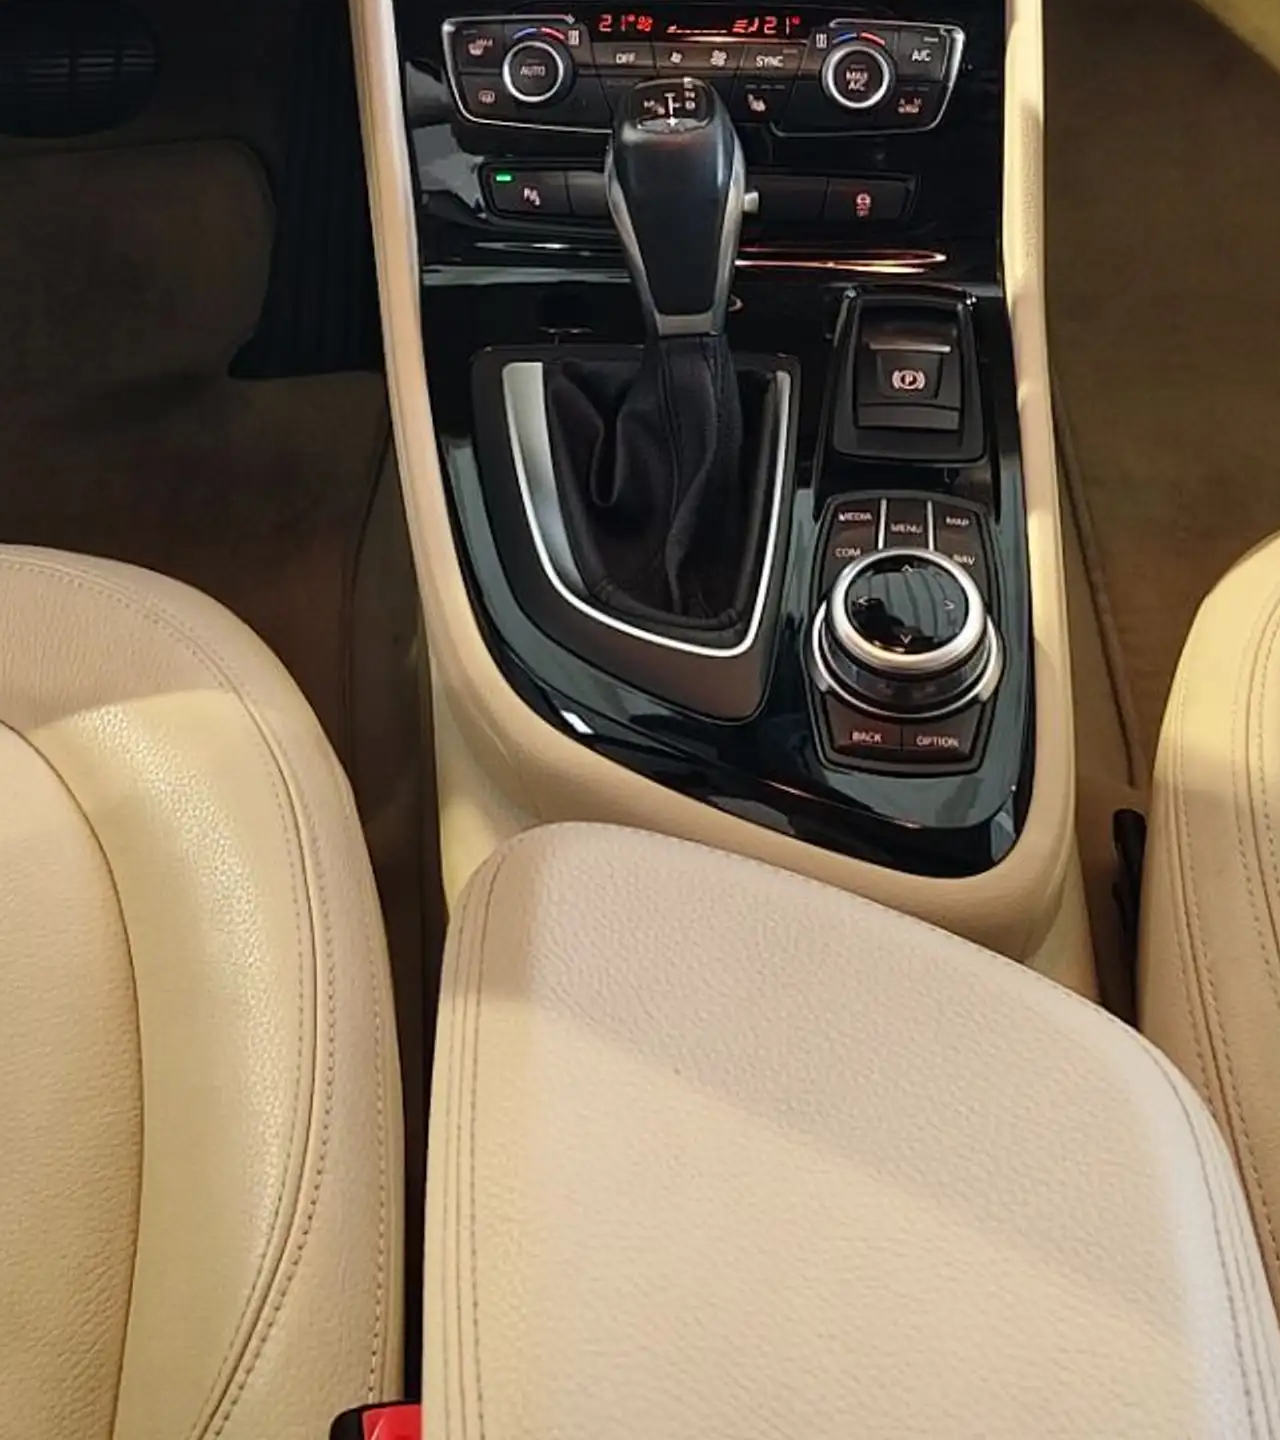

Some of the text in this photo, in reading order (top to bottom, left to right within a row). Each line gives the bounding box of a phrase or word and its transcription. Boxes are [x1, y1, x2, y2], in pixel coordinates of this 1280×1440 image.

[615, 52, 636, 64] OFF
[755, 55, 784, 68] SYNC
[520, 65, 546, 77] AUTO
[838, 511, 873, 522] MEDIA
[890, 522, 923, 534] MENU
[835, 547, 862, 558] COM
[851, 730, 882, 743] BACK
[915, 735, 960, 749] OPTION
